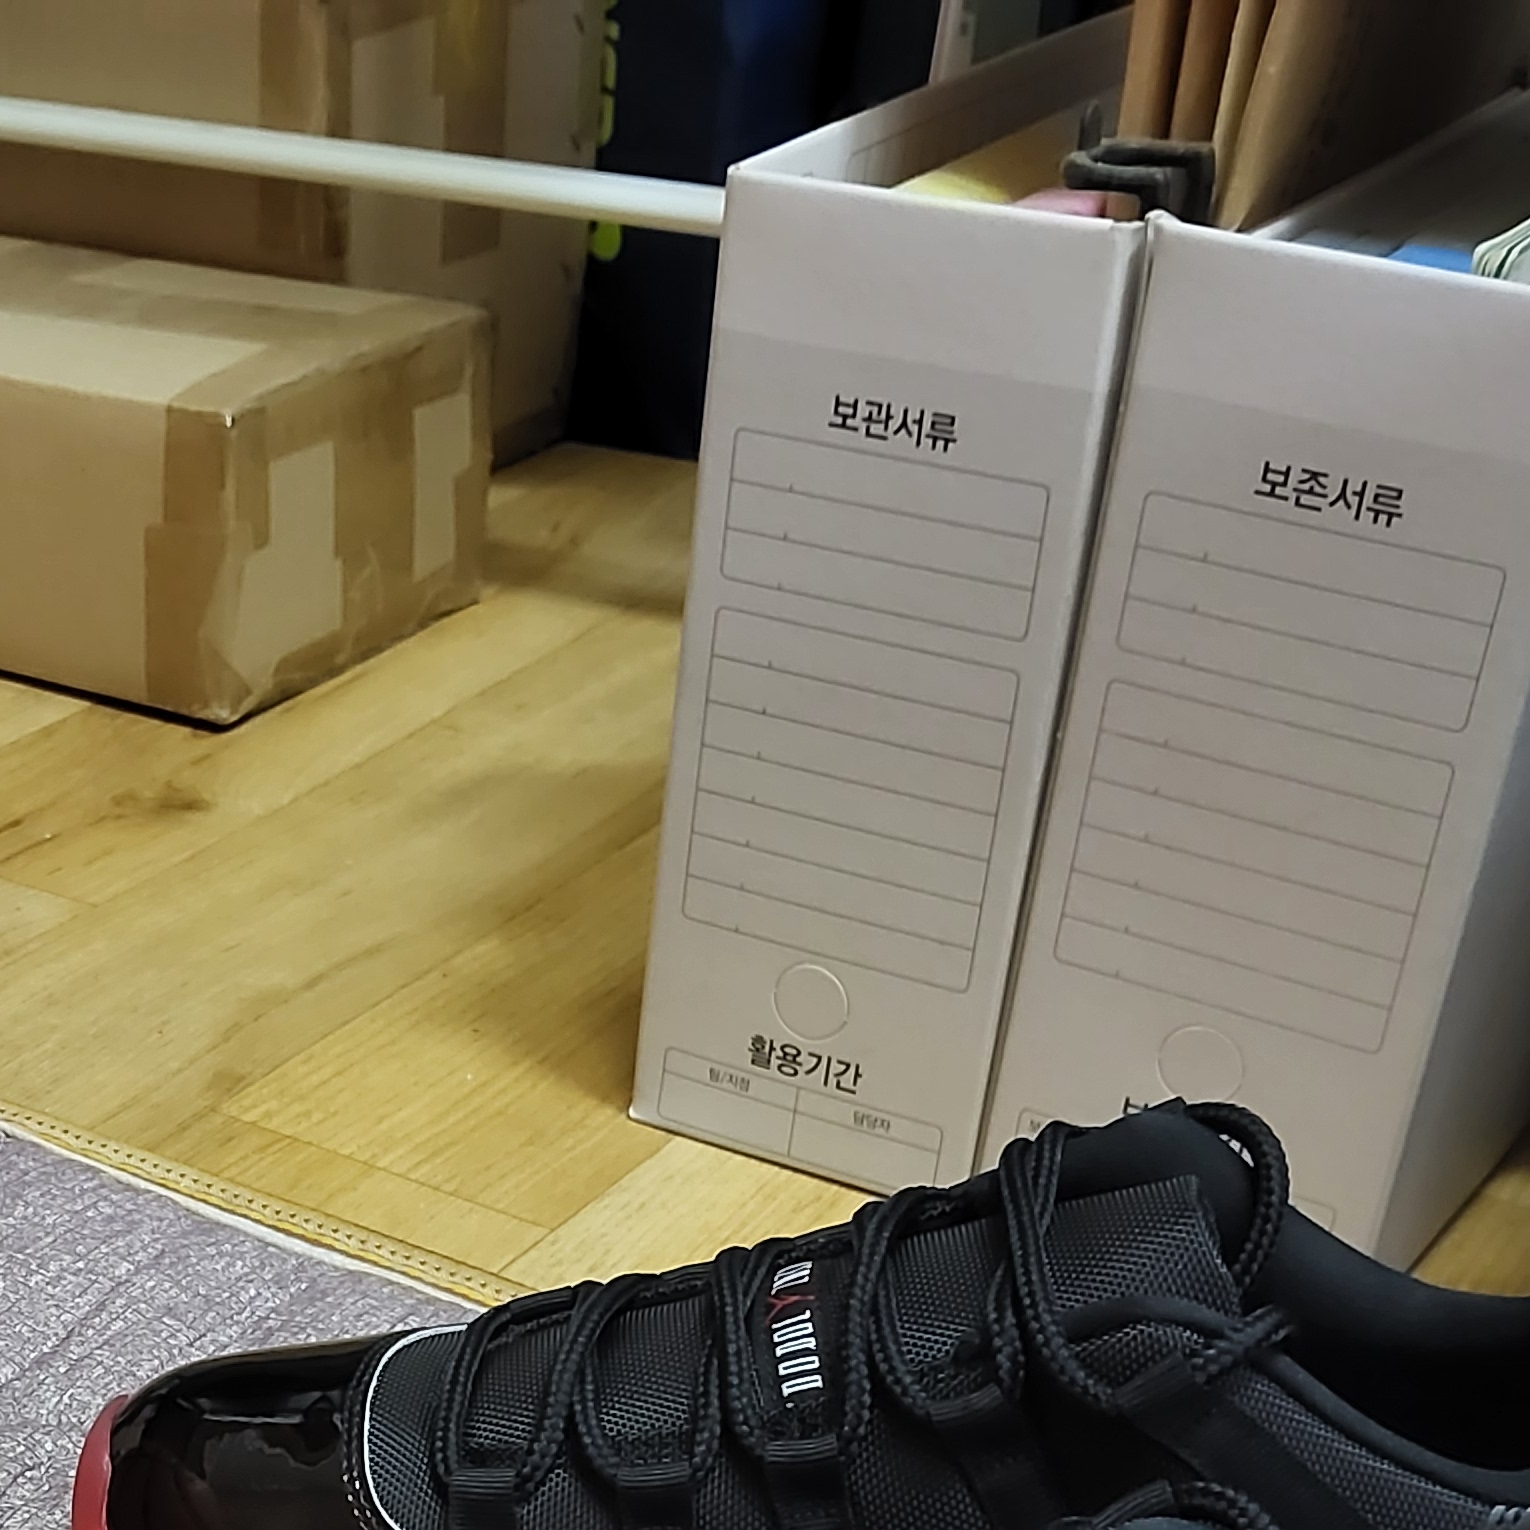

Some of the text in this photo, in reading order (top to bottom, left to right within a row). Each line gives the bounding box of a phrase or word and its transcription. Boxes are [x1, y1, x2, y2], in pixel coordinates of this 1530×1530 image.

[827, 393, 958, 454] 보관서류
[1253, 459, 1405, 530] 보존서류
[747, 1034, 864, 1096] 활용기간
